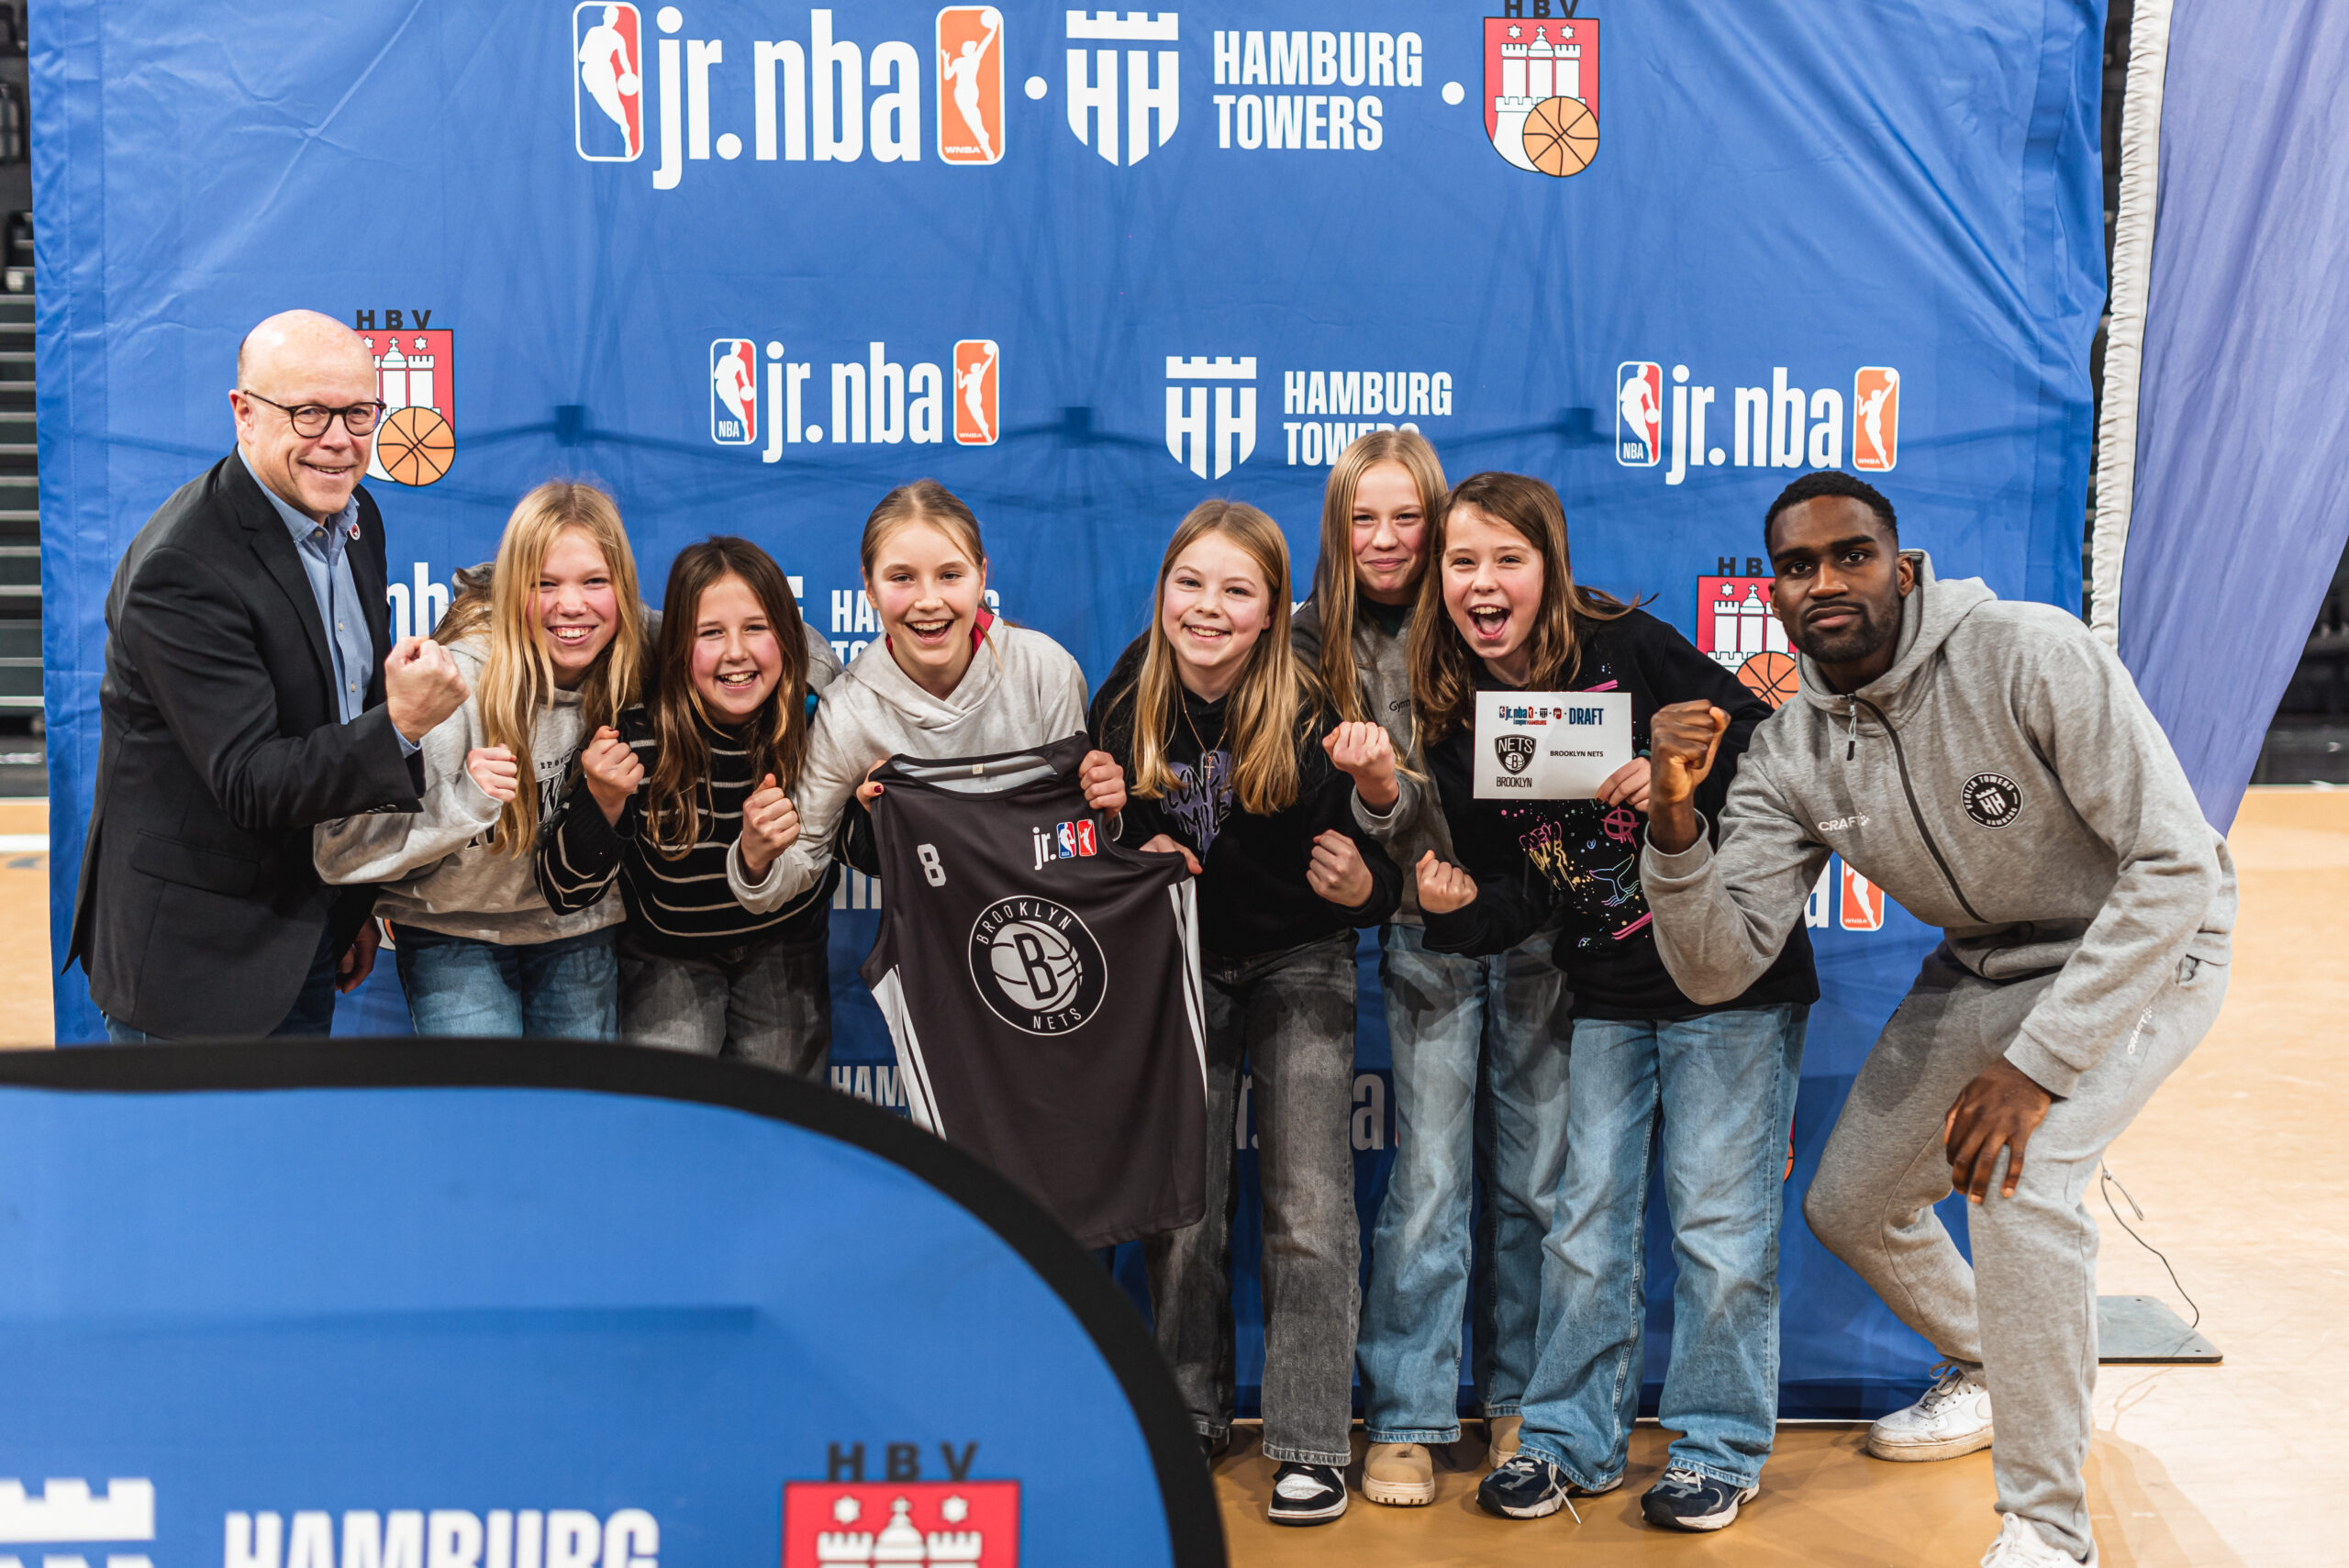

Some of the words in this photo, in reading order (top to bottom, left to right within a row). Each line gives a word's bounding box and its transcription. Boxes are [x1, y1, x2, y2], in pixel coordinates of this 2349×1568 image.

[1214, 30, 1423, 88] HAMBURG
[652, 6, 921, 190] jr.nba
[1213, 94, 1384, 151] TOWERS
[944, 146, 981, 154] WNBA
[763, 340, 943, 463] jr.nba
[1284, 371, 1453, 416] HAMBURG
[718, 420, 740, 438] NBA
[1665, 364, 1843, 485] jr.nba
[1623, 442, 1644, 460] NBA
[1569, 708, 1604, 725] DRAFT
[1498, 738, 1533, 753] NETS
[1496, 776, 1532, 788] BROOKLYN
[1964, 780, 1978, 810] VEOLIA
[1978, 775, 2015, 791] TOWERS
[1986, 807, 2019, 826] HAMBURG
[917, 843, 947, 888] 8
[1032, 826, 1057, 871] jr.
[975, 901, 1073, 946] BROOKLYN
[1012, 932, 1060, 1001] B
[1033, 1007, 1083, 1030] NETS
